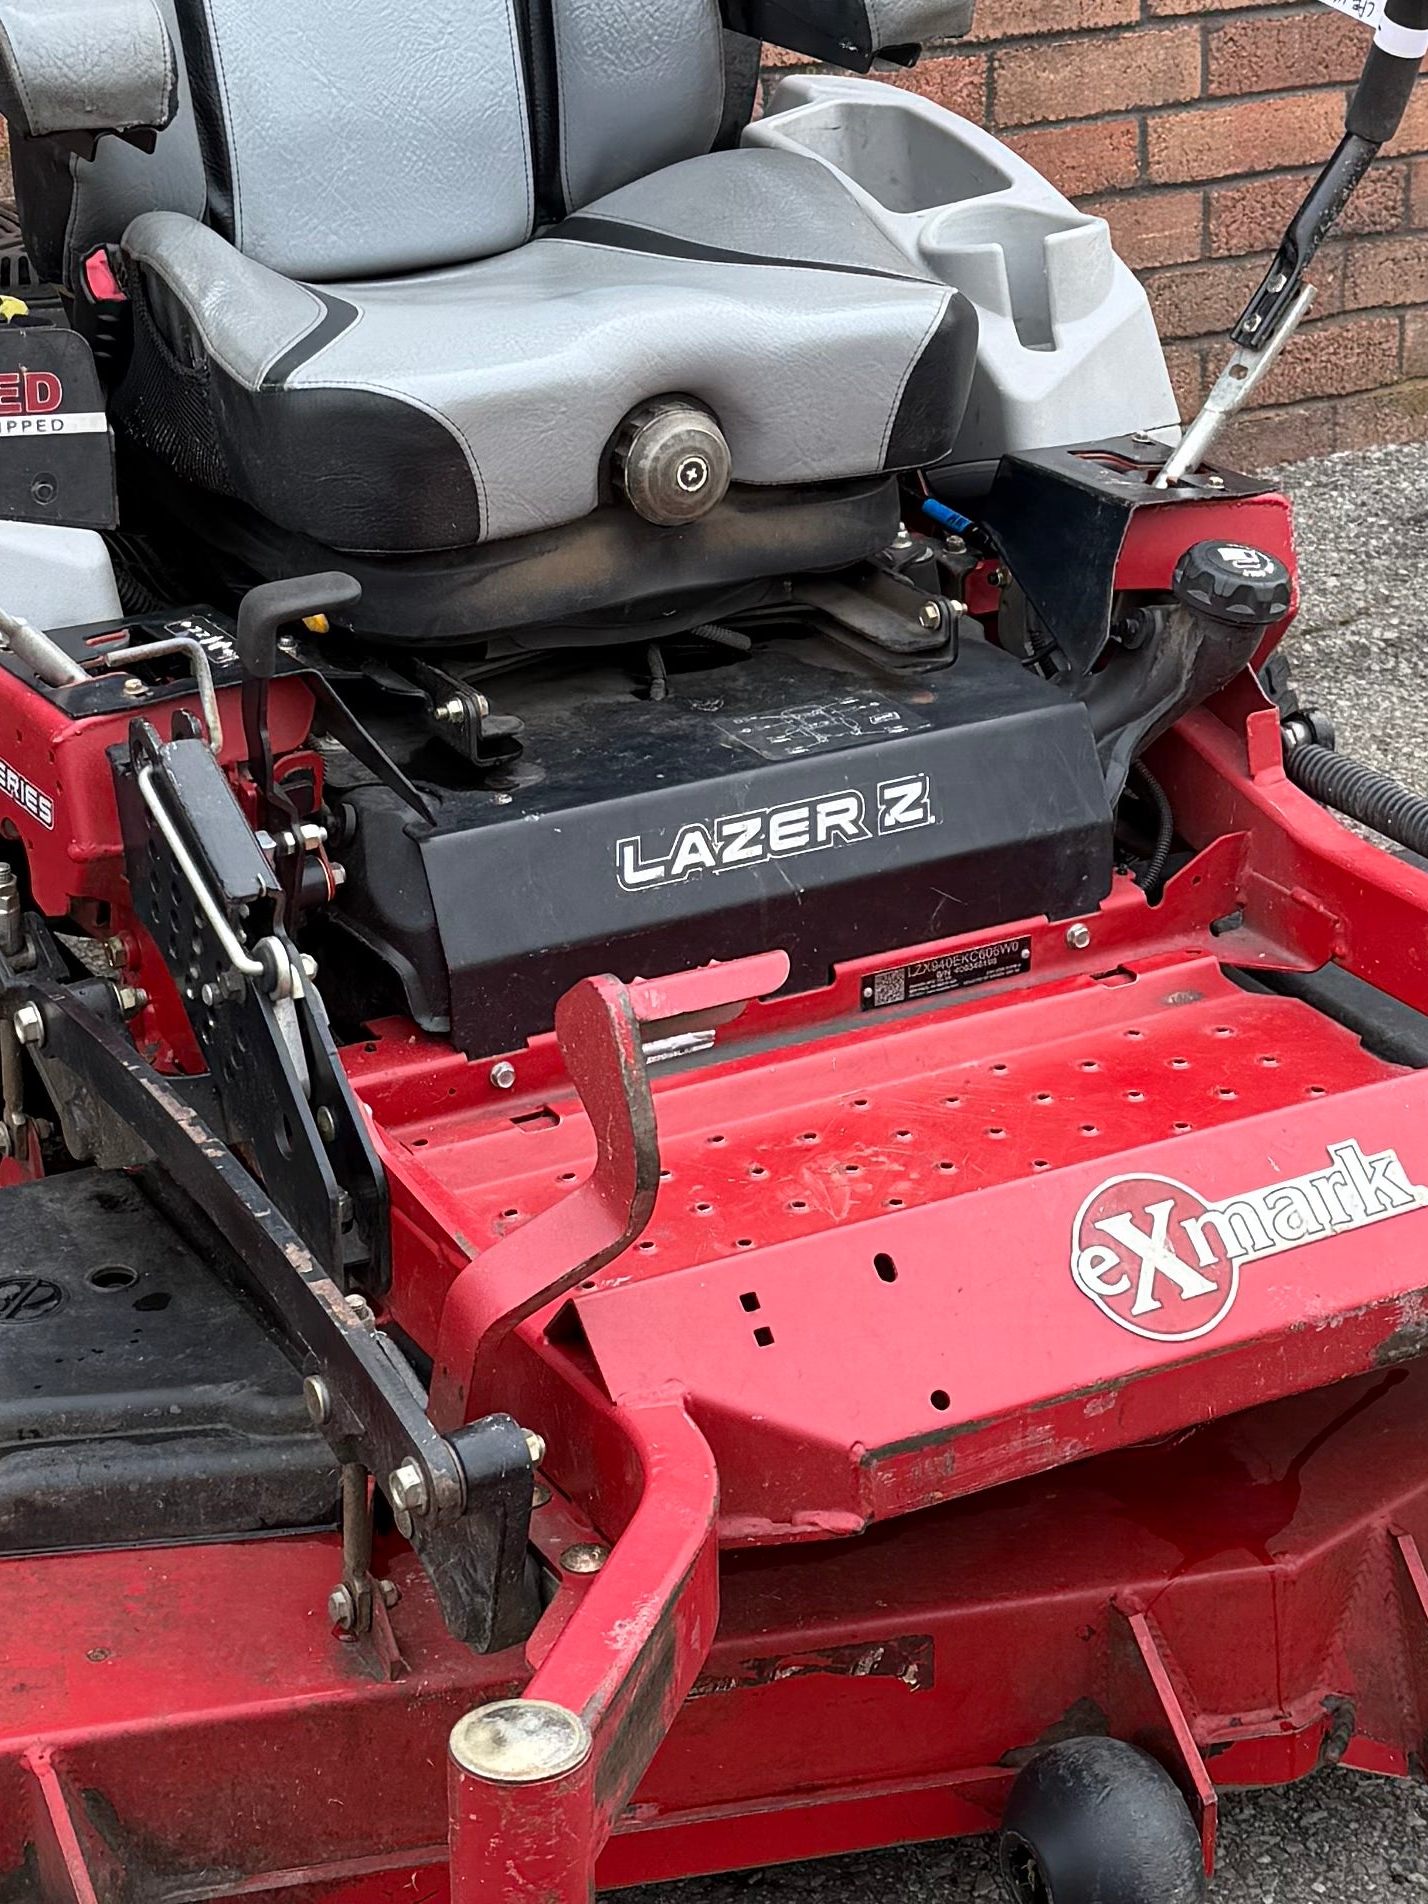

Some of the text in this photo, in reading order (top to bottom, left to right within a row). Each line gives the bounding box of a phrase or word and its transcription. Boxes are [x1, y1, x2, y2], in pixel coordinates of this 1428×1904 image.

[620, 780, 926, 887] LAZER Z
[1076, 1144, 1416, 1318] eXmark
